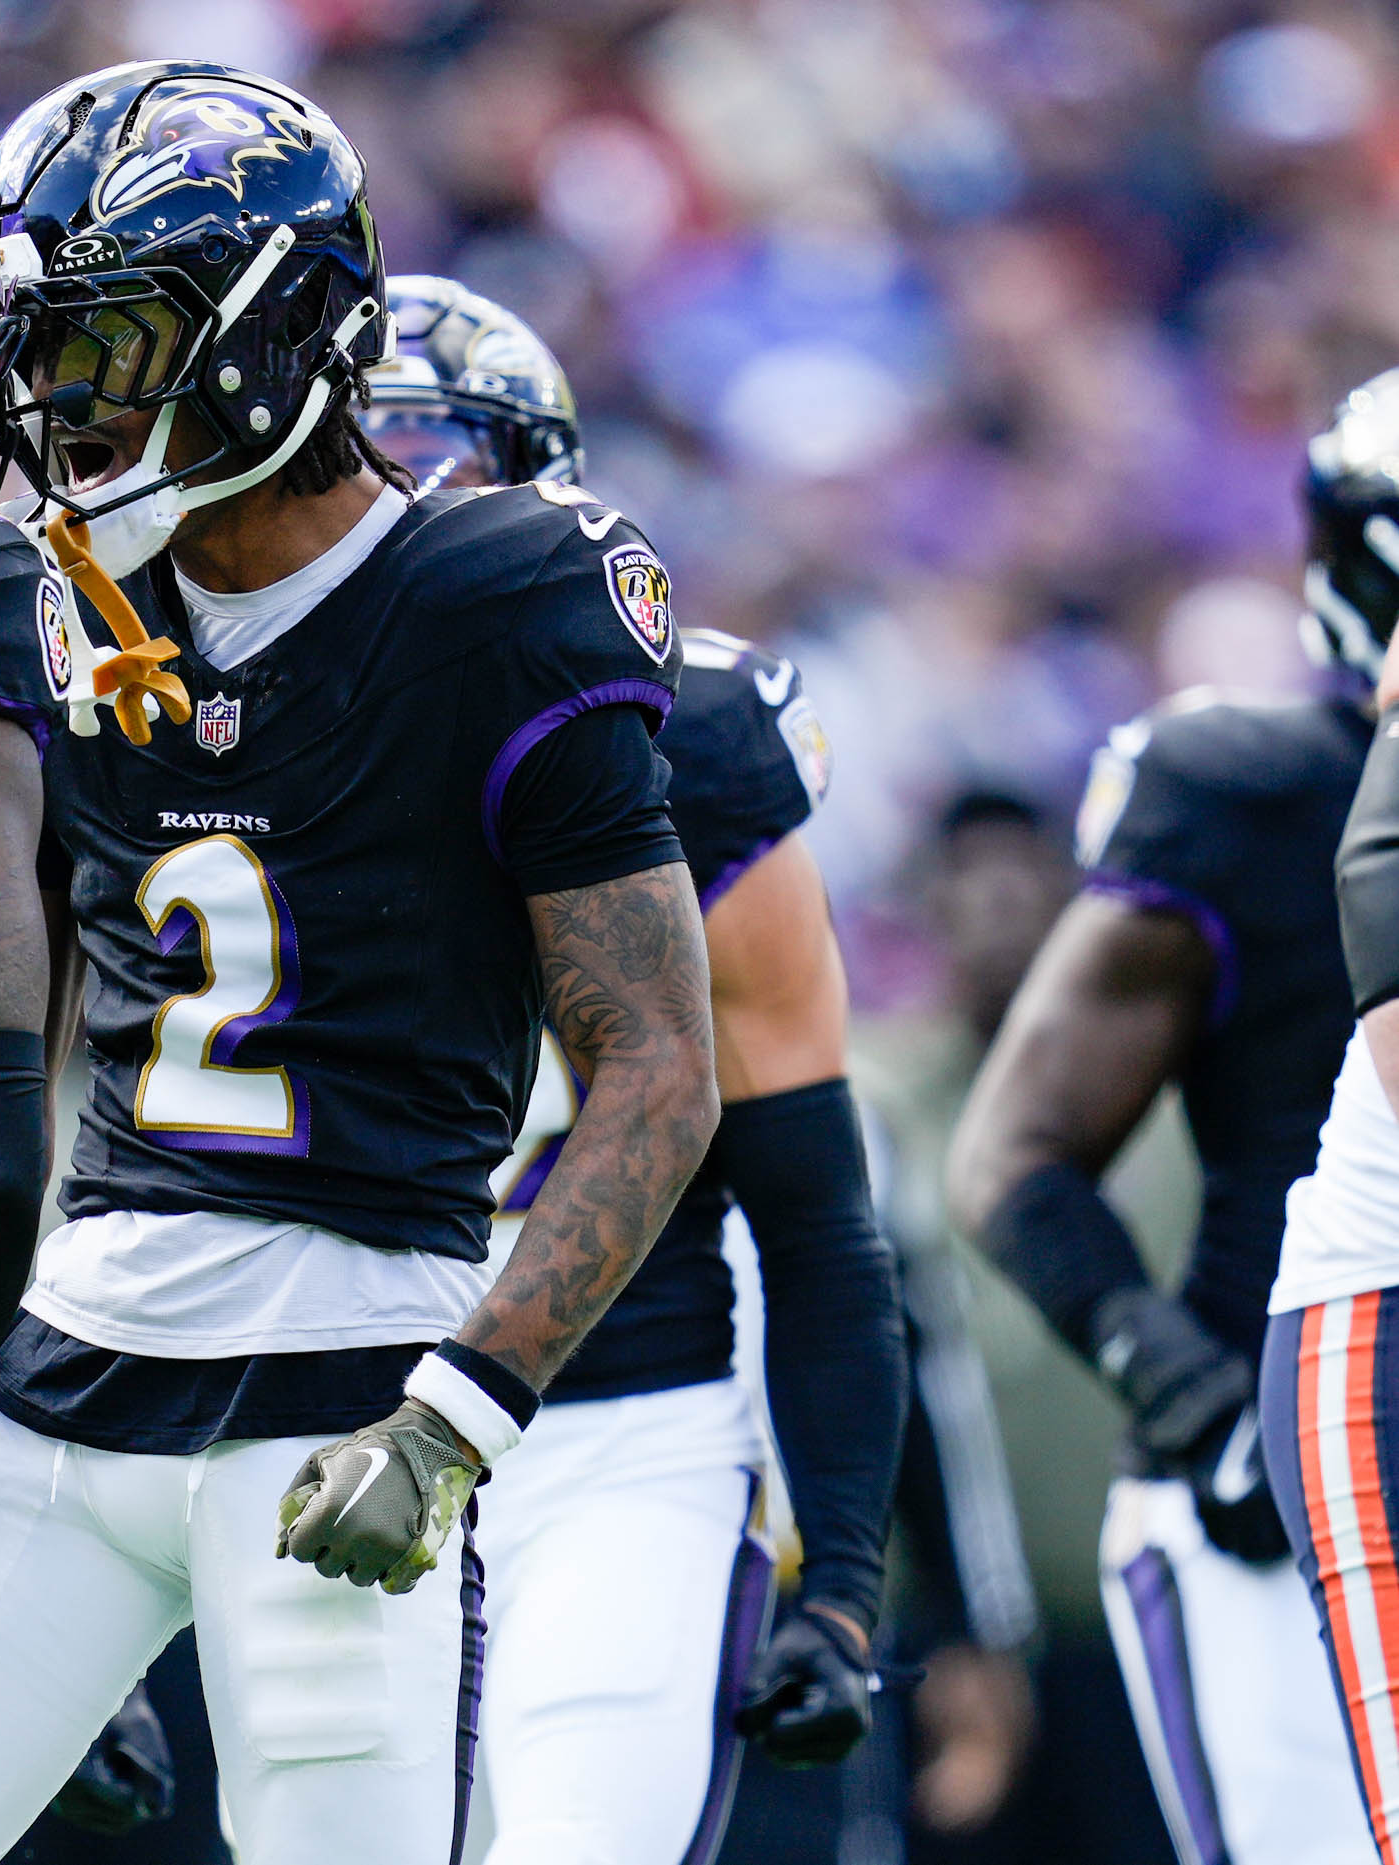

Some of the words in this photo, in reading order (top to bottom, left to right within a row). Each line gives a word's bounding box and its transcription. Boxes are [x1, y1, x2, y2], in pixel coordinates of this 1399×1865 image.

[54, 250, 116, 272] OAKLEY
[616, 569, 648, 600] B
[203, 721, 233, 744] NFL
[157, 811, 271, 832] RAVENS
[134, 833, 310, 1157] 2
